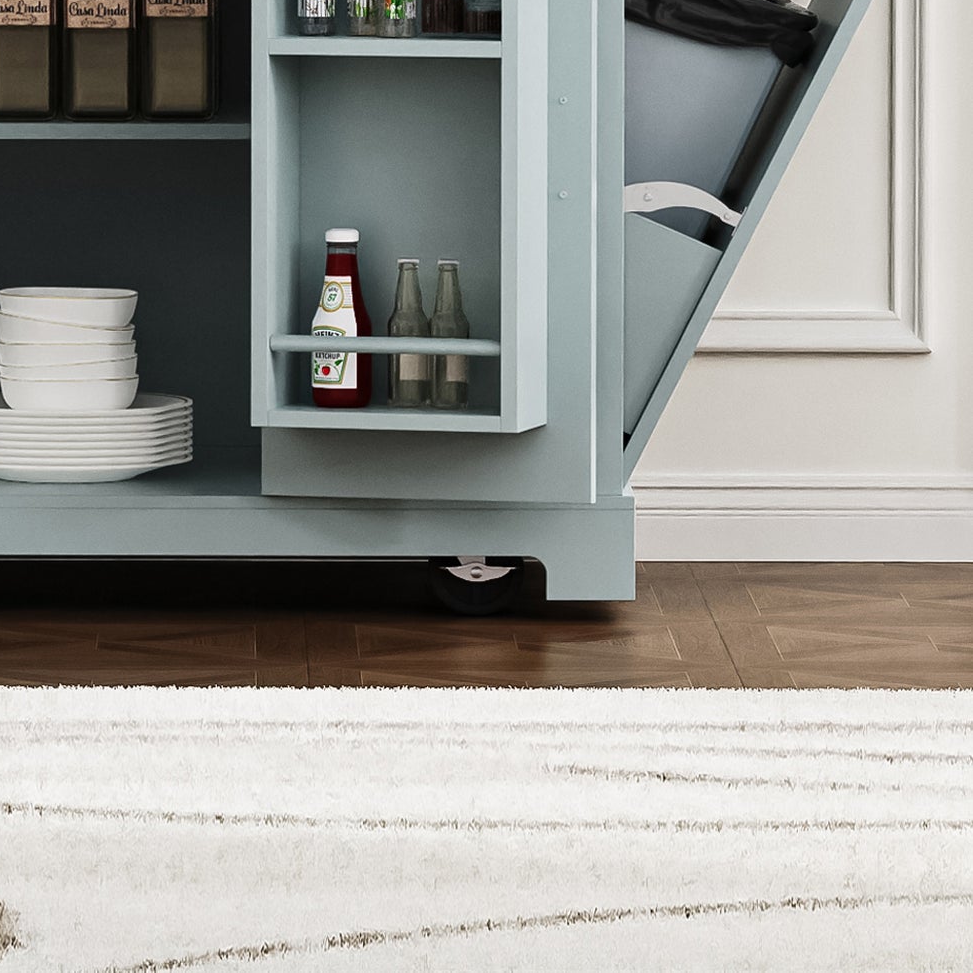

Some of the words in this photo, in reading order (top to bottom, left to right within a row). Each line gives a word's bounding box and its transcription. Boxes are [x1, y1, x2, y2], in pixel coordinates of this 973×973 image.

[16, 0, 48, 15] Linda
[69, 2, 94, 16] Casa
[96, 2, 127, 18] Linda
